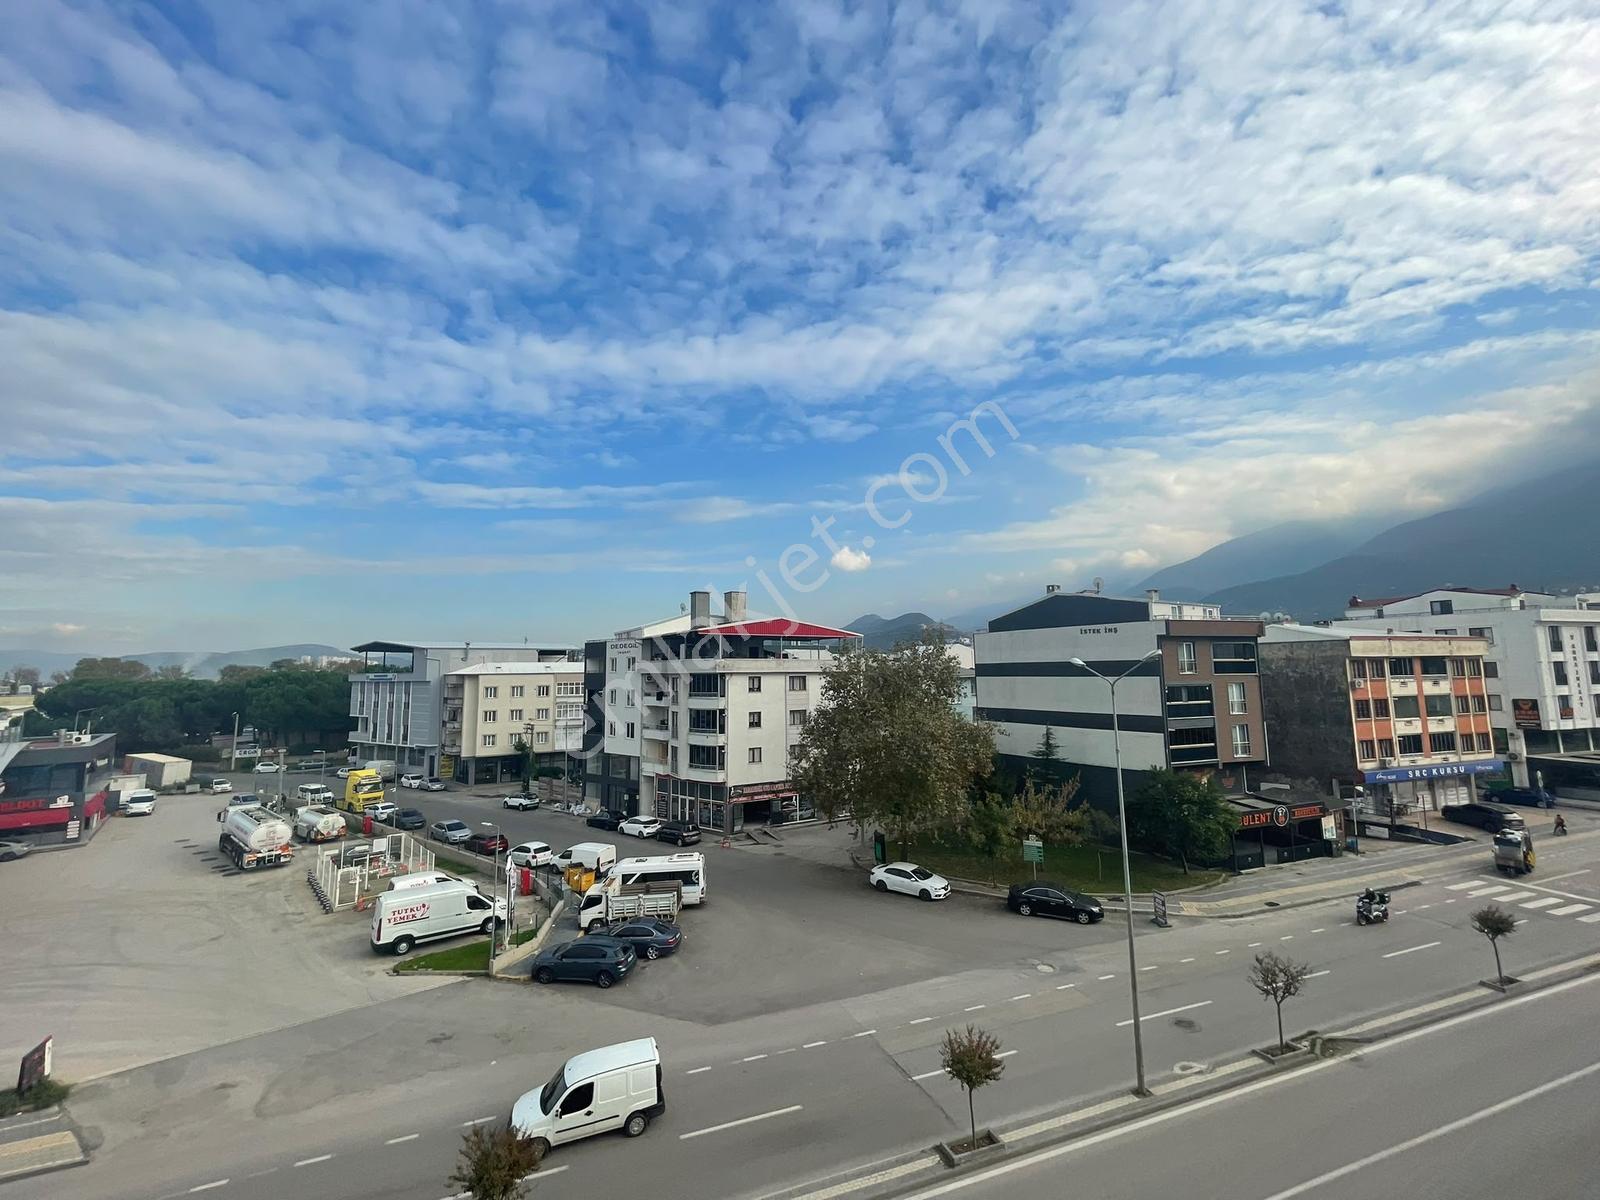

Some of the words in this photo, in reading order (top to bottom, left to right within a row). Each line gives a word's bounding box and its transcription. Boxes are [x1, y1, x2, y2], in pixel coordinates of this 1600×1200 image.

[1408, 769, 1428, 778] SRC
[1432, 766, 1465, 776] KURSU
[391, 905, 422, 916] TUTKU
[387, 913, 418, 923] YEMEK
